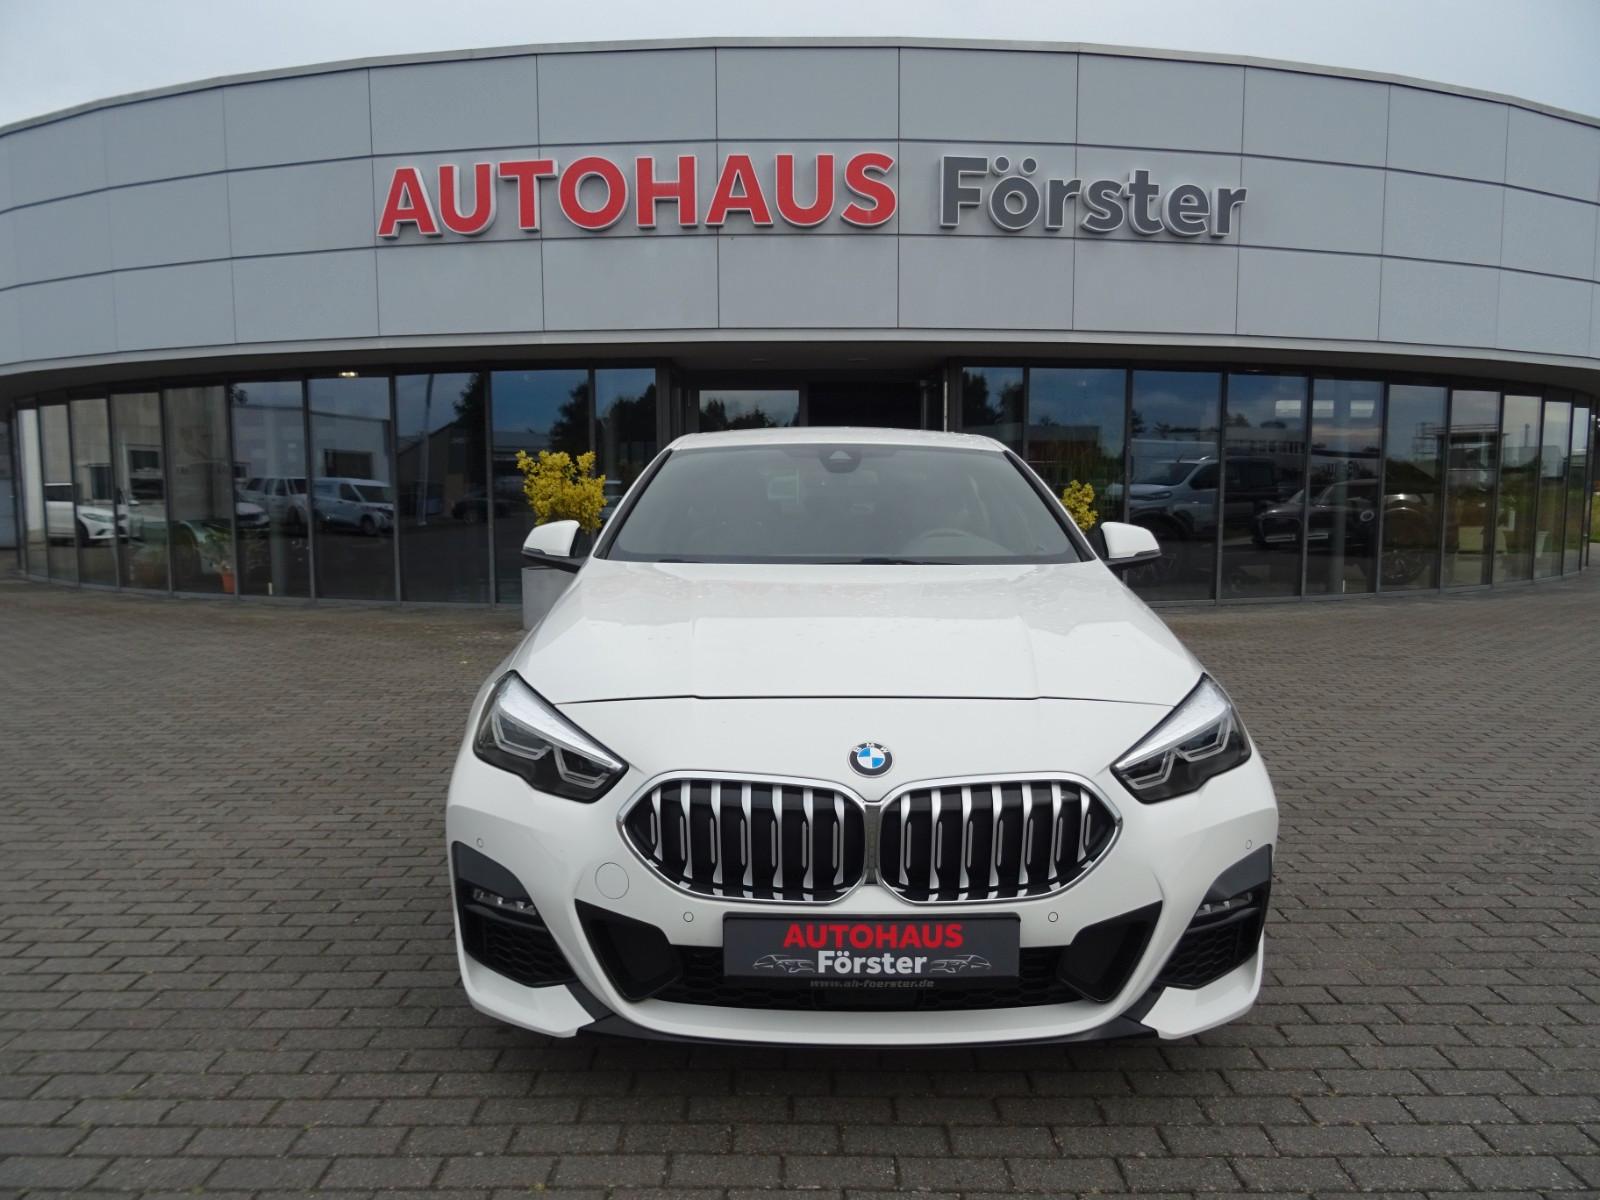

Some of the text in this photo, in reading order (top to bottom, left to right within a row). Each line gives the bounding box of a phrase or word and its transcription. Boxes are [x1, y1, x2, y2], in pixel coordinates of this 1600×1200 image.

[376, 153, 1247, 239] AUTOHAUS Förster
[784, 923, 964, 949] AUTOHAUS
[818, 950, 928, 974] Förster
[810, 979, 935, 988] www.ah-foerster.de
